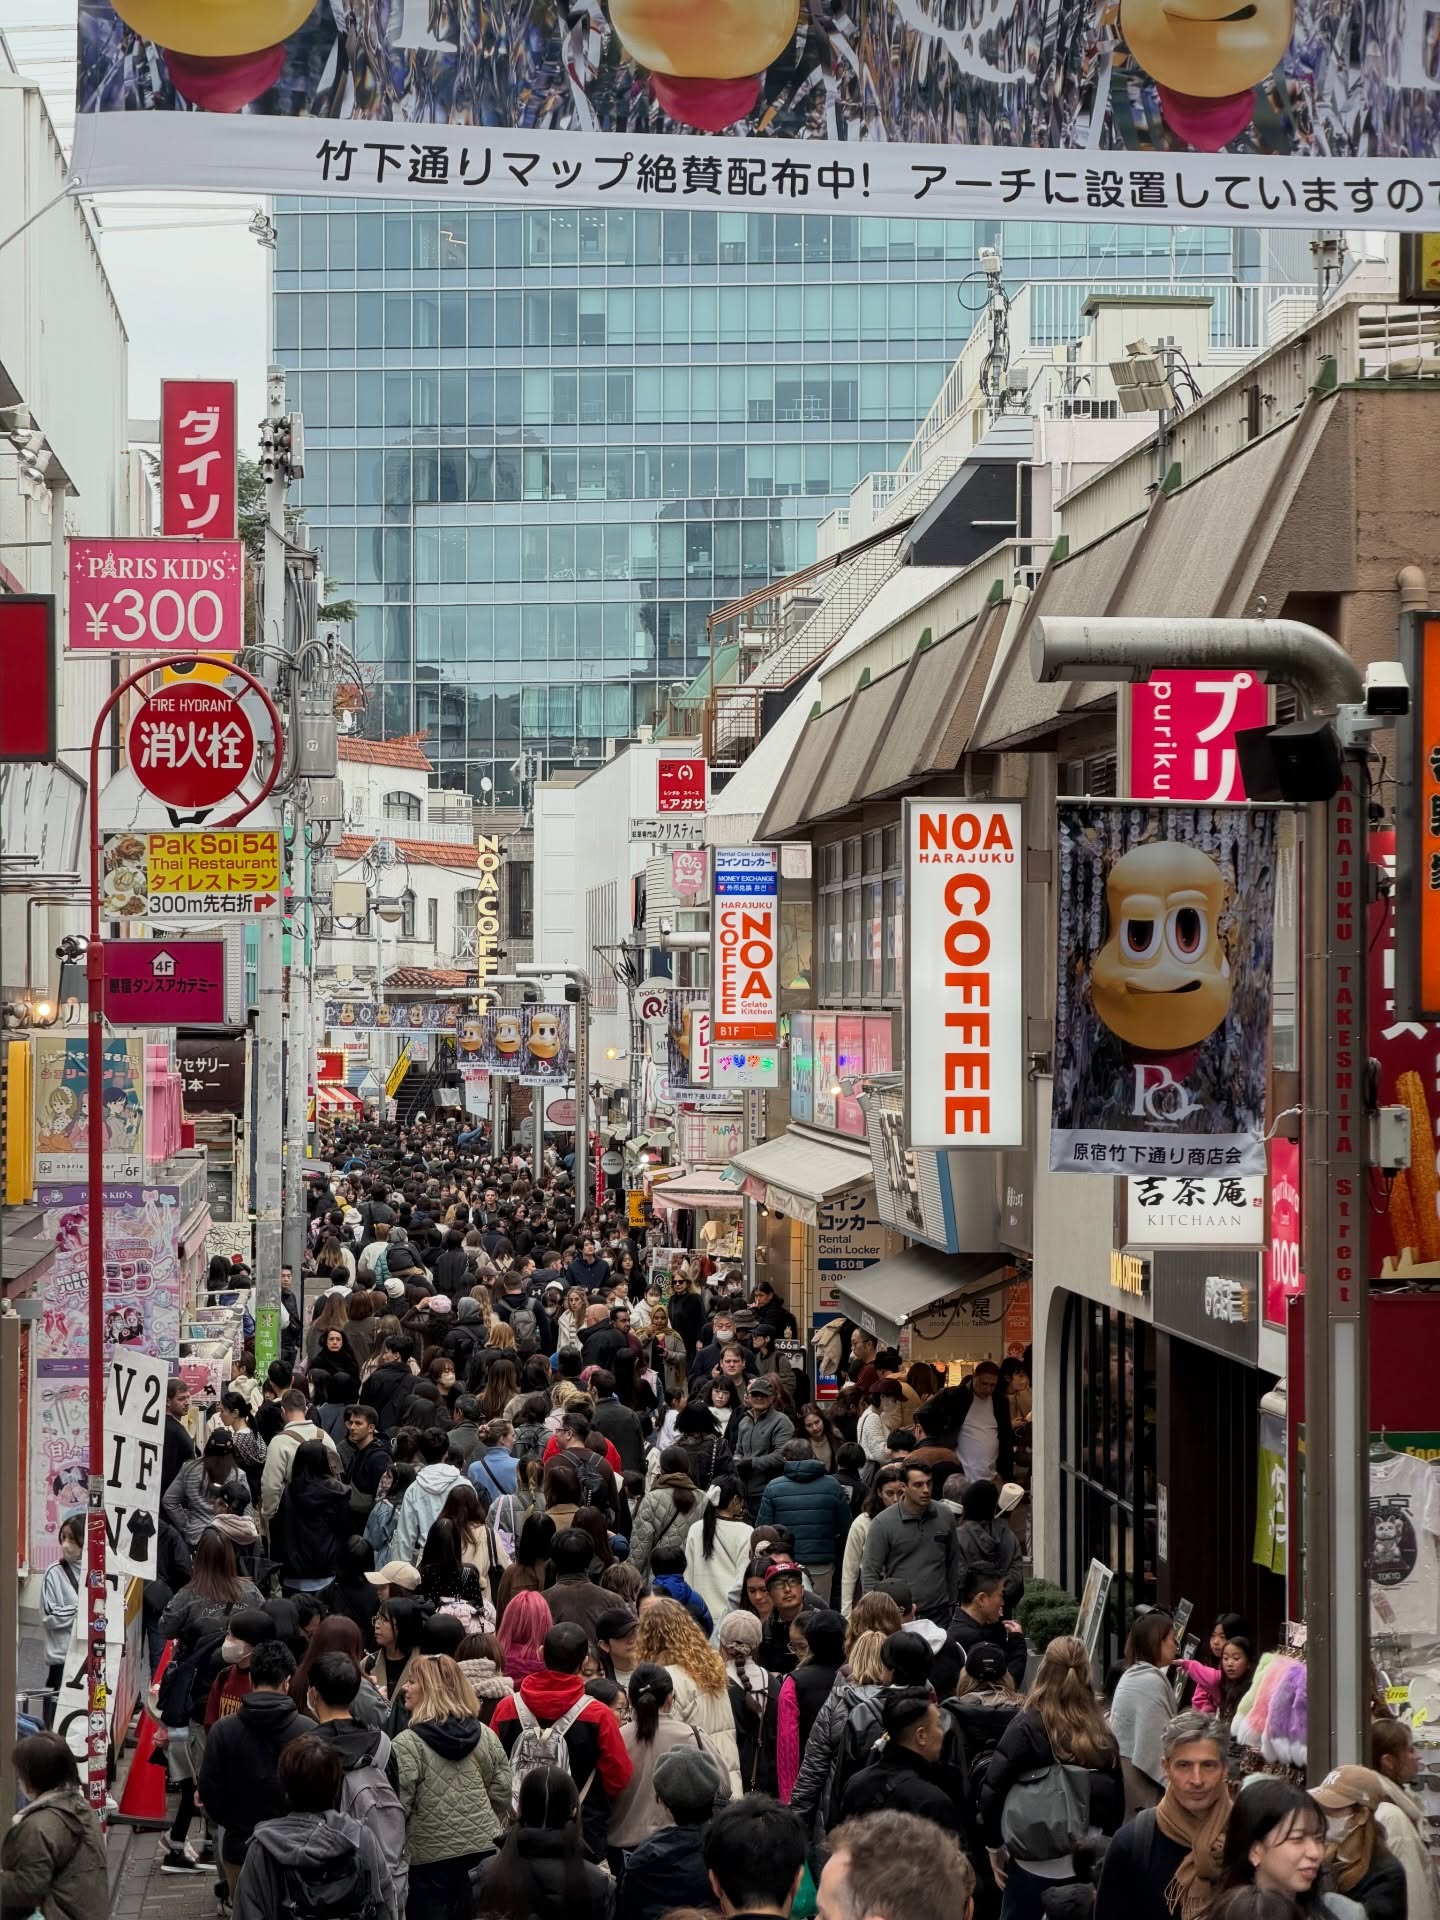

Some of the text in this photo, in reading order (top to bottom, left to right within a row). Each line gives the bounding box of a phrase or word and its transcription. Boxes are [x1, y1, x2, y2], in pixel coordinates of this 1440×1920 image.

[316, 139, 871, 199] 竹下通りマップ絶賛配布中!
[177, 405, 222, 538] ダイソ
[162, 557, 226, 581] KID'S
[85, 588, 223, 643] ¥300
[150, 698, 234, 714] FIRE HYDRANT
[139, 720, 245, 770] 消火栓
[1148, 680, 1178, 800] puriku
[669, 798, 705, 810] アガサ
[657, 823, 702, 840] クリスティー
[919, 813, 1013, 850] NOA
[150, 833, 278, 856] Pak Soi 54
[150, 857, 278, 871] Thai Restaurant
[716, 857, 771, 867] コインロッカー
[919, 852, 1015, 864] HARAJUKU
[150, 873, 278, 892] タイレストラン
[149, 894, 253, 915] 300m先右折
[720, 901, 773, 909] HARAJUKU
[720, 911, 739, 1015] COFFEE
[739, 911, 774, 999] NOA
[154, 960, 173, 972] 4F
[642, 996, 669, 1020] Ri
[943, 872, 991, 1135] COFFEE
[720, 1026, 740, 1037] B1F
[1335, 965, 1353, 1154] TAKESHITA
[1072, 1142, 1243, 1166] 原宿竹下通り商店会
[125, 1166, 140, 1177] 6F
[1147, 1214, 1242, 1227] KITCHAAN
[818, 1234, 852, 1244] Rental
[818, 1245, 880, 1255] Coin Locker
